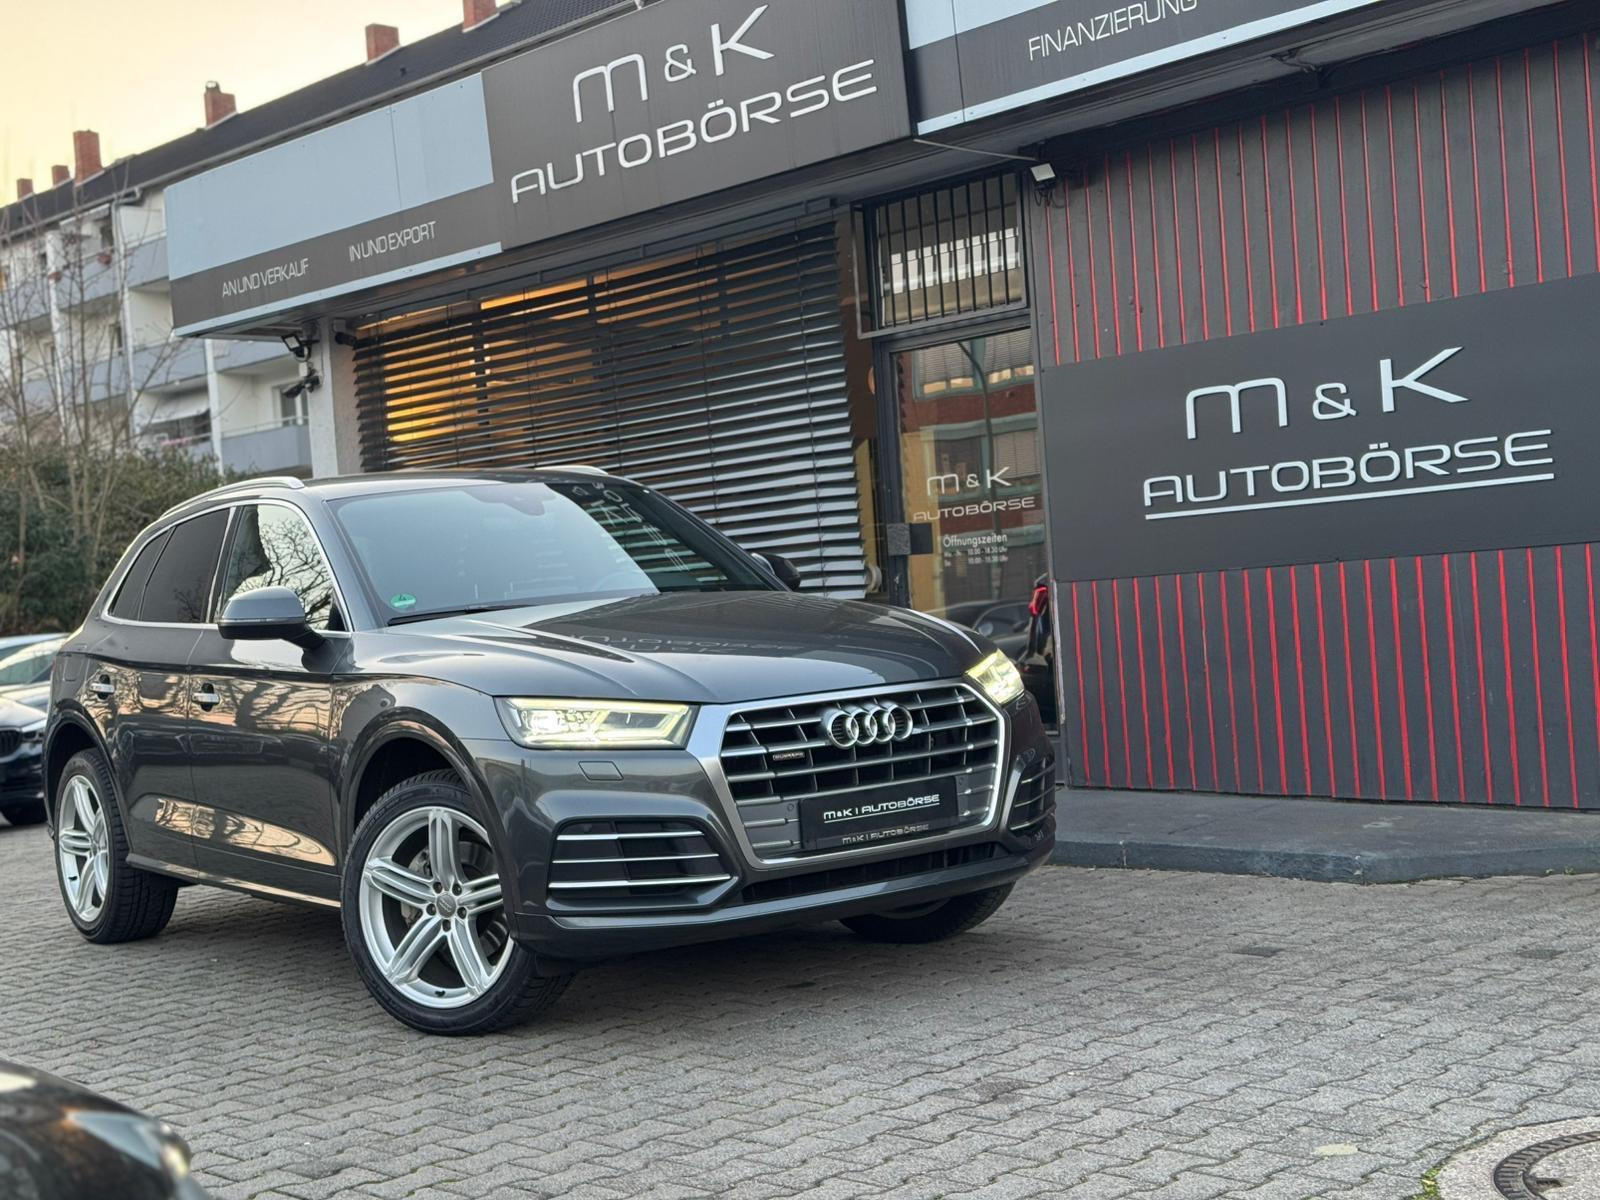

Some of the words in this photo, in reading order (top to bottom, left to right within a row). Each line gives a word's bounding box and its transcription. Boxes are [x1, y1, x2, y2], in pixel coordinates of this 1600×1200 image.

[664, 43, 698, 82] &
[710, 4, 775, 76] K
[510, 58, 878, 204] AUTOBÖRSE
[387, 220, 437, 250] EXPORT
[259, 257, 309, 288] VERKAUF
[1312, 382, 1357, 421] &
[1379, 346, 1470, 413] K
[966, 473, 981, 488] &
[986, 466, 1012, 489] K
[1143, 429, 1554, 507] AUTOBÖRSE
[912, 496, 1036, 522] AUTOBÖRSE
[943, 531, 1008, 548] Öffnungszeiten
[861, 794, 940, 814] AUTOBÖRSE
[870, 823, 930, 840] AUTOBÖRSE
